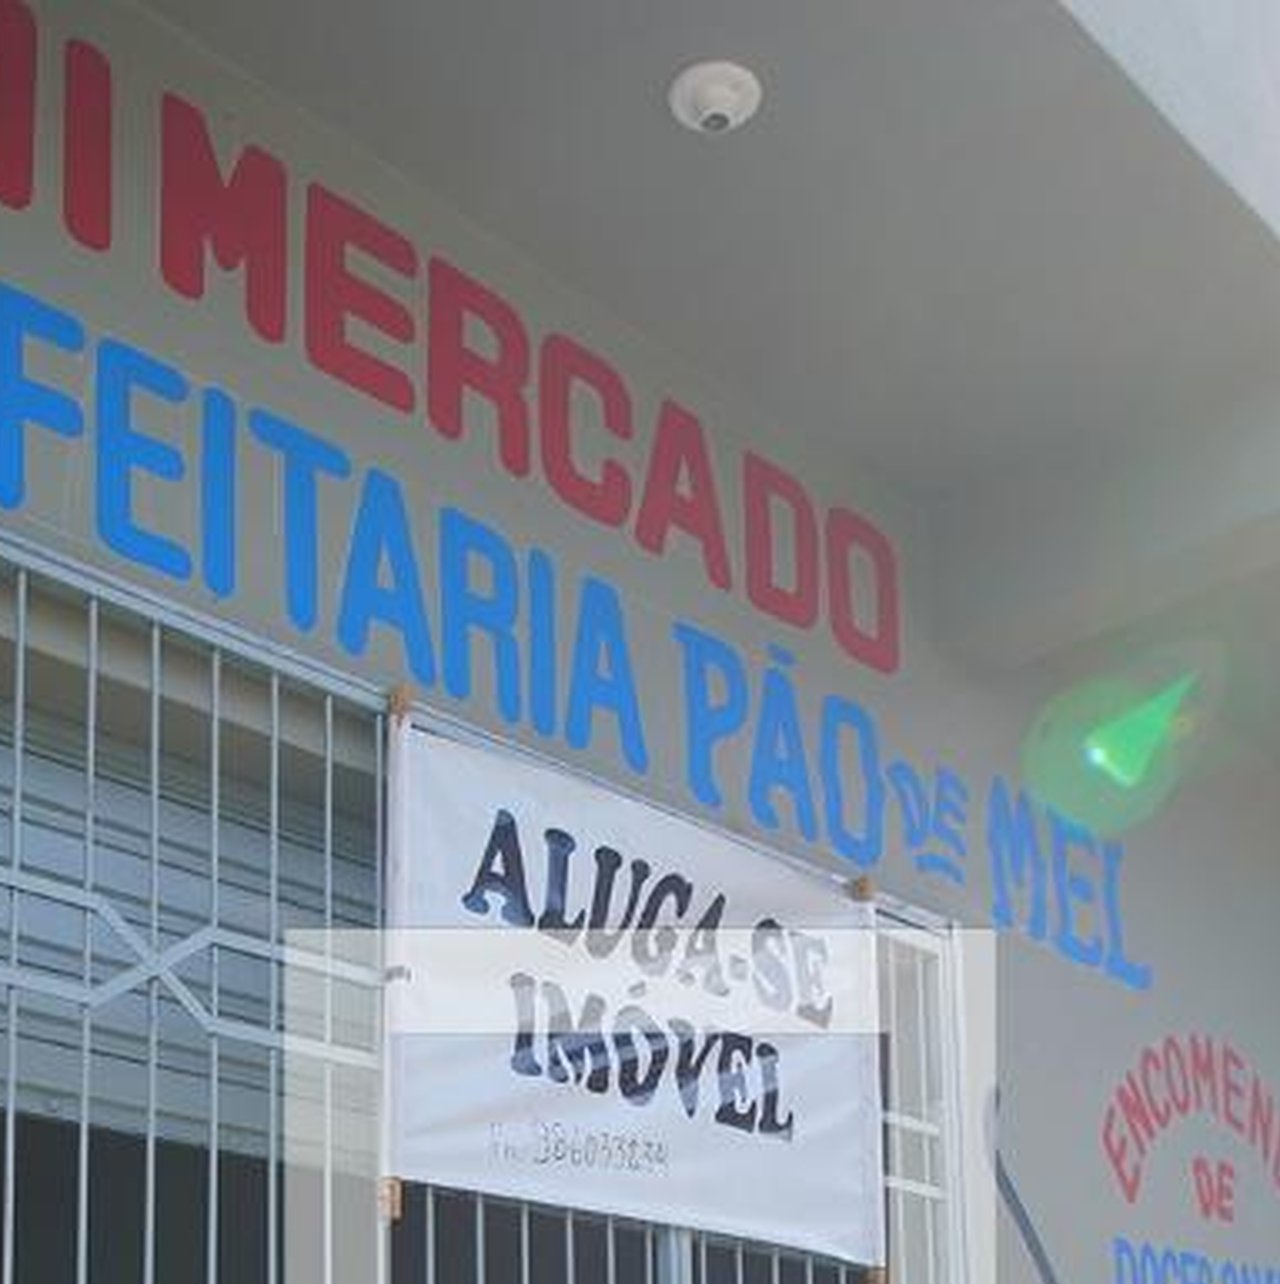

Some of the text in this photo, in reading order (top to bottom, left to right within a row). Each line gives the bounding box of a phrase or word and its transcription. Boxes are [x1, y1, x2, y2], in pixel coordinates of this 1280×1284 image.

[160, 93, 900, 675] MERCADO
[671, 620, 886, 869] PÃO
[884, 760, 966, 858] DE
[986, 773, 1154, 990] MEL
[462, 808, 834, 1029] ALUGA-SE
[508, 968, 794, 1142] IMÓVEL
[1192, 1155, 1235, 1222] DE
